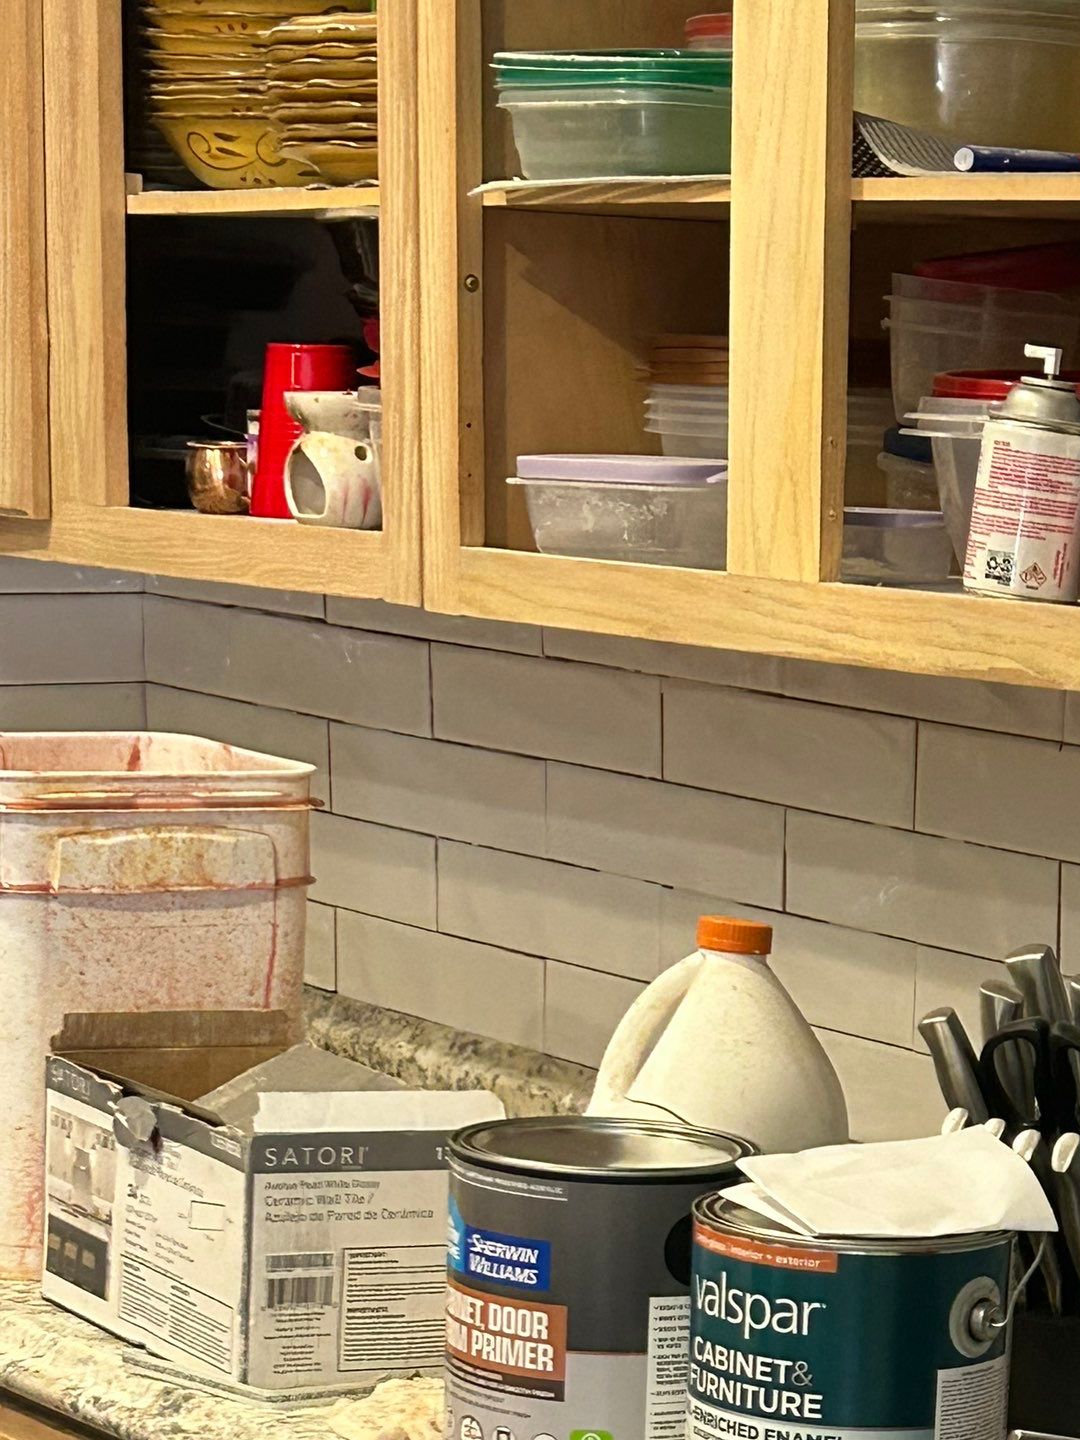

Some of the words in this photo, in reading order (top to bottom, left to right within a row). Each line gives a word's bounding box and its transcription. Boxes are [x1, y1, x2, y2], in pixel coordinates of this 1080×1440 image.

[264, 1146, 369, 1167] SATORI
[467, 1233, 539, 1264] SHERWIN
[775, 1256, 821, 1268] exterior
[469, 1253, 539, 1285] WILLIAMS
[488, 1302, 549, 1340] DOOR
[696, 1271, 824, 1340] valspar
[471, 1328, 554, 1372] PRIMER
[690, 1362, 823, 1419] FURNITURE
